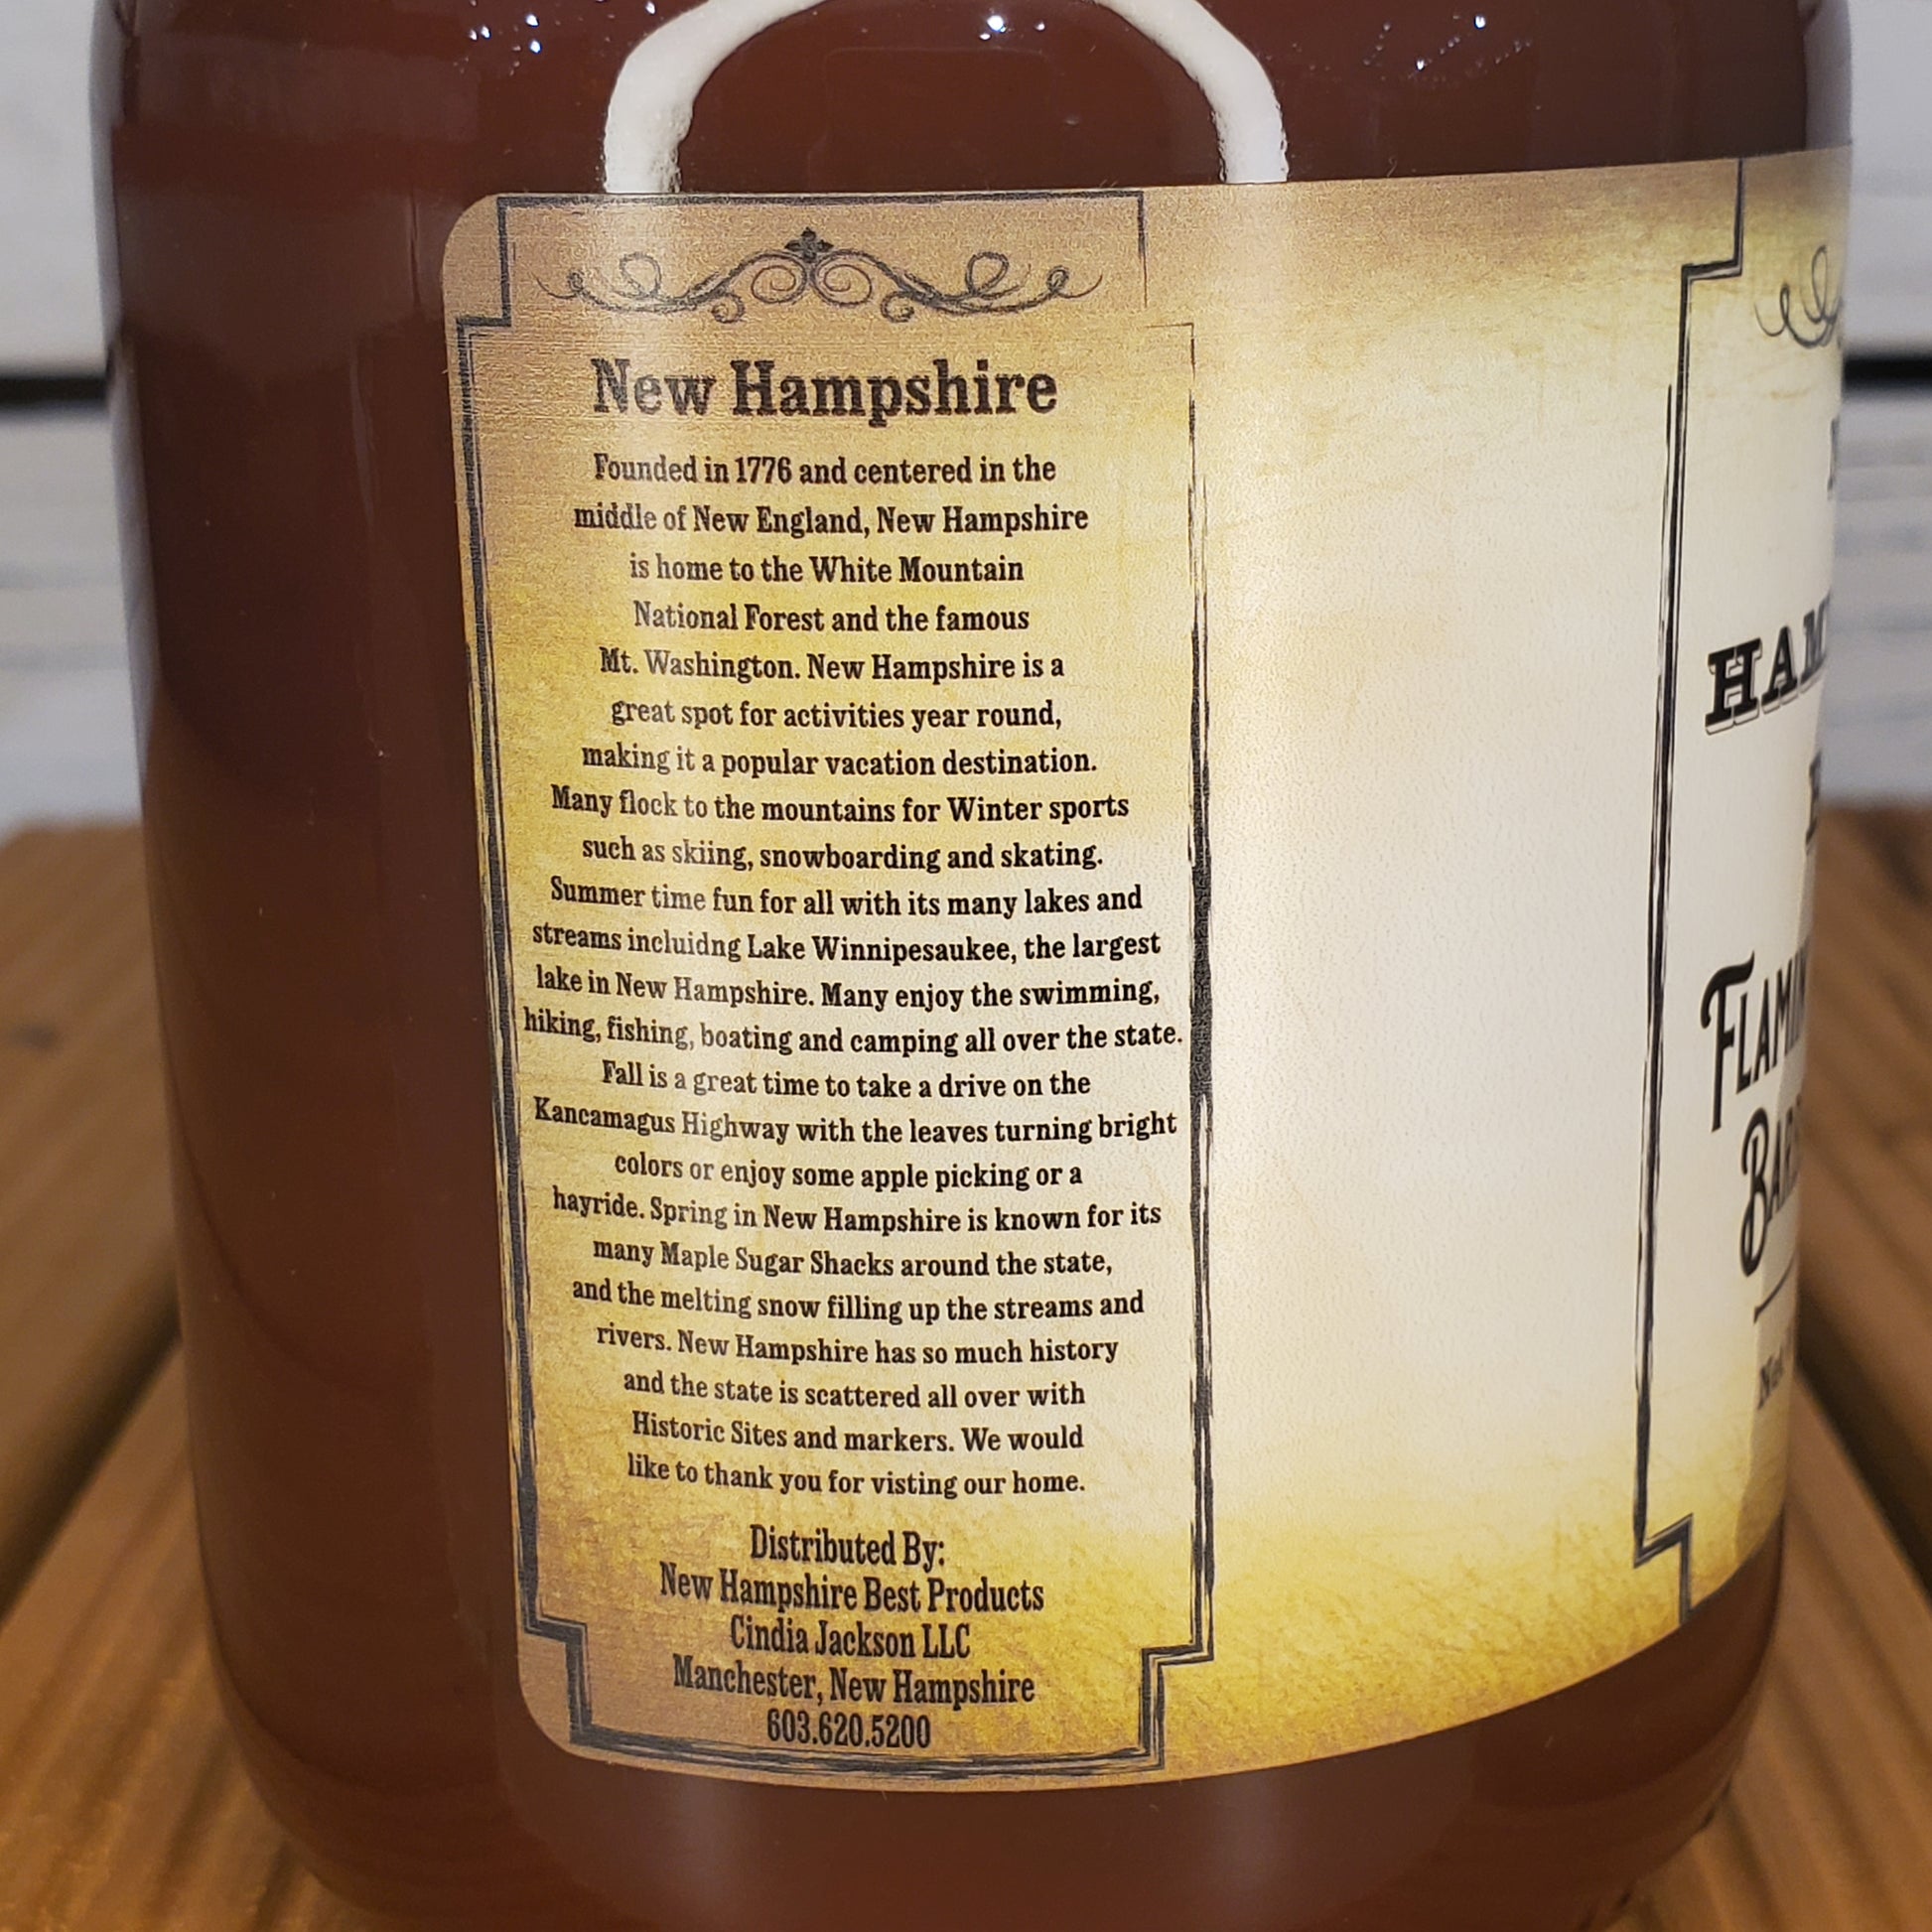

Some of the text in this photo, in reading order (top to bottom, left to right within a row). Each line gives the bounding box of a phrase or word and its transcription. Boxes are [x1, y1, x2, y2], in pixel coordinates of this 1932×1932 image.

[592, 357, 1057, 429] New Hampshire
[593, 452, 1056, 485] Founded in 1776 and centered in the
[573, 500, 1089, 540] middle of New England, New Hampshire
[629, 551, 1025, 584] is home to the White Mountain
[632, 600, 1031, 632] National Forest and the famous
[598, 645, 1065, 686] Mt. Washington. New Hampshire is a
[611, 698, 1062, 734] great spot for activities year round,
[581, 741, 1098, 779] making it a popular vacation destination.
[550, 783, 1130, 826] Many flock to the mountains for Winter sports
[582, 834, 1104, 875] such as skiing, snowboarding and skating.
[532, 921, 1162, 967] streams incluidng Lake Winnipesaukee, the largest
[535, 963, 1161, 1014] lake in New Hampshire. Many enjoy the swimming,
[522, 1005, 1183, 1058] hiking, fishing, boating and camping all over the state.
[532, 1095, 1177, 1146] Kancamagus Highway with the leaves turning bright
[552, 1183, 1163, 1238] hayride. Spring in New Hampshire is known for its
[592, 1240, 1113, 1278] many Maple Sugar Shacks around the state,
[572, 1277, 1145, 1326] and the melting snow filling up the streams and
[596, 1321, 1119, 1366] rivers. New Hampshire has so much history
[631, 1409, 1085, 1452] Historic Sites and markers. We would
[626, 1451, 1086, 1501] like to thank you for visting our home.
[749, 1523, 945, 1575] Distributed By:
[658, 1560, 1044, 1614] New Hampshire Best Products
[729, 1613, 971, 1660] Cindia Jackson LLC
[672, 1652, 1036, 1713] Manchester, New Hampshire
[766, 1707, 931, 1749] 603.620.5200
